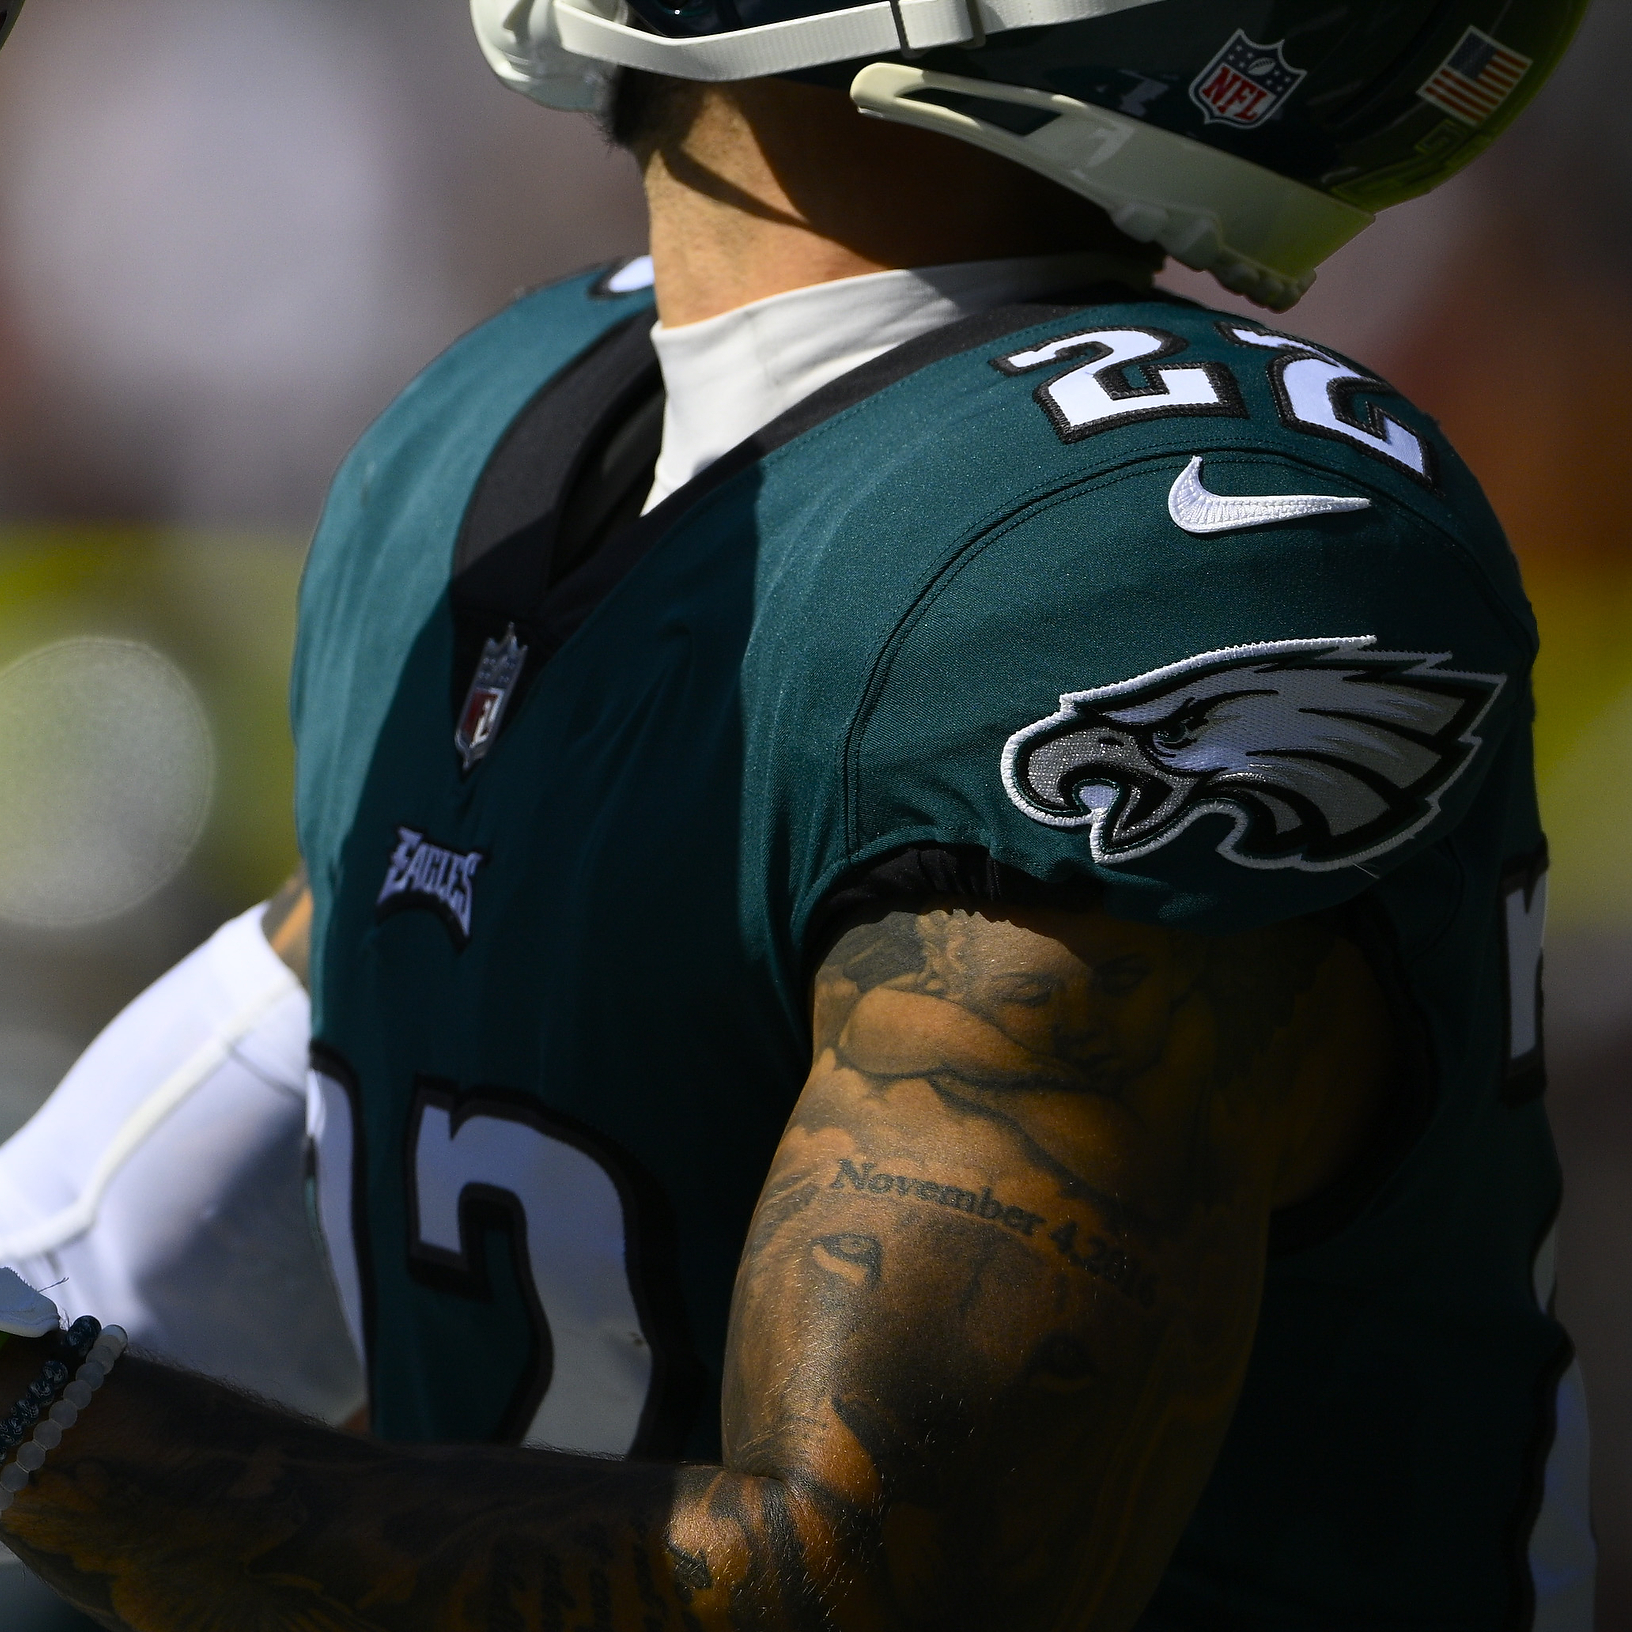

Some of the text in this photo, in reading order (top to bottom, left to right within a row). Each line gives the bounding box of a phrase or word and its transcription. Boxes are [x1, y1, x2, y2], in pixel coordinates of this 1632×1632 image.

[1201, 68, 1268, 121] NFL
[989, 322, 1439, 491] 22
[374, 824, 486, 941] EAGLES
[307, 1044, 691, 1464] 2
[831, 1158, 1046, 1236] November
